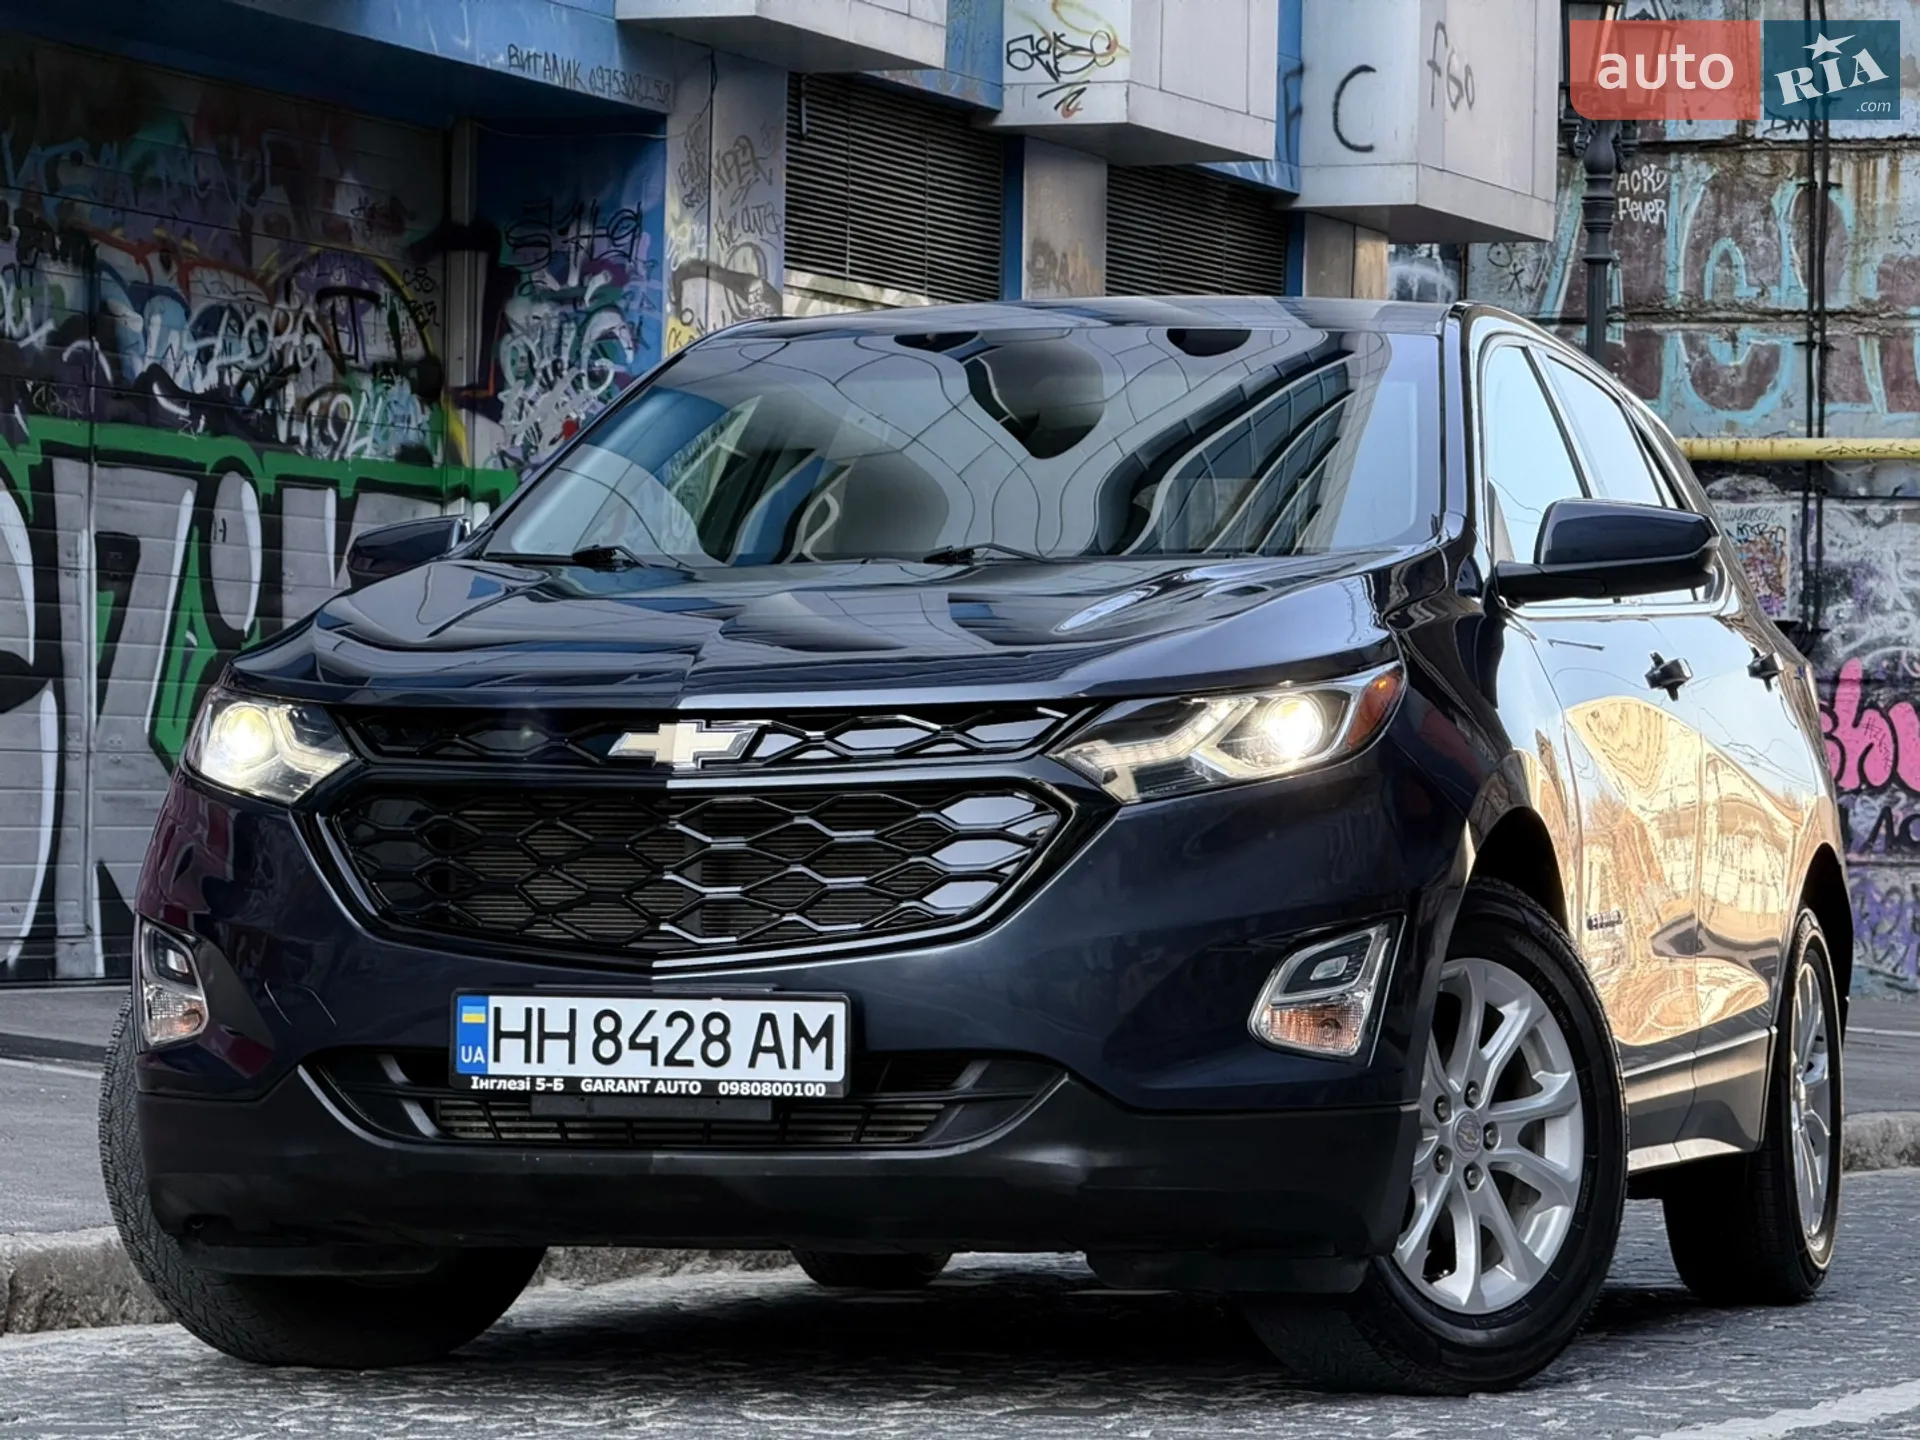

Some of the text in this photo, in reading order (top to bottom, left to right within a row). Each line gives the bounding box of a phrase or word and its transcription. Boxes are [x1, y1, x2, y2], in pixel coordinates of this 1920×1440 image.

[592, 1008, 731, 1068] 8428
[748, 1012, 834, 1070] AM
[461, 1046, 485, 1064] UA
[581, 1078, 702, 1095] GARANT AUTO
[718, 1081, 827, 1097] 0980800100
